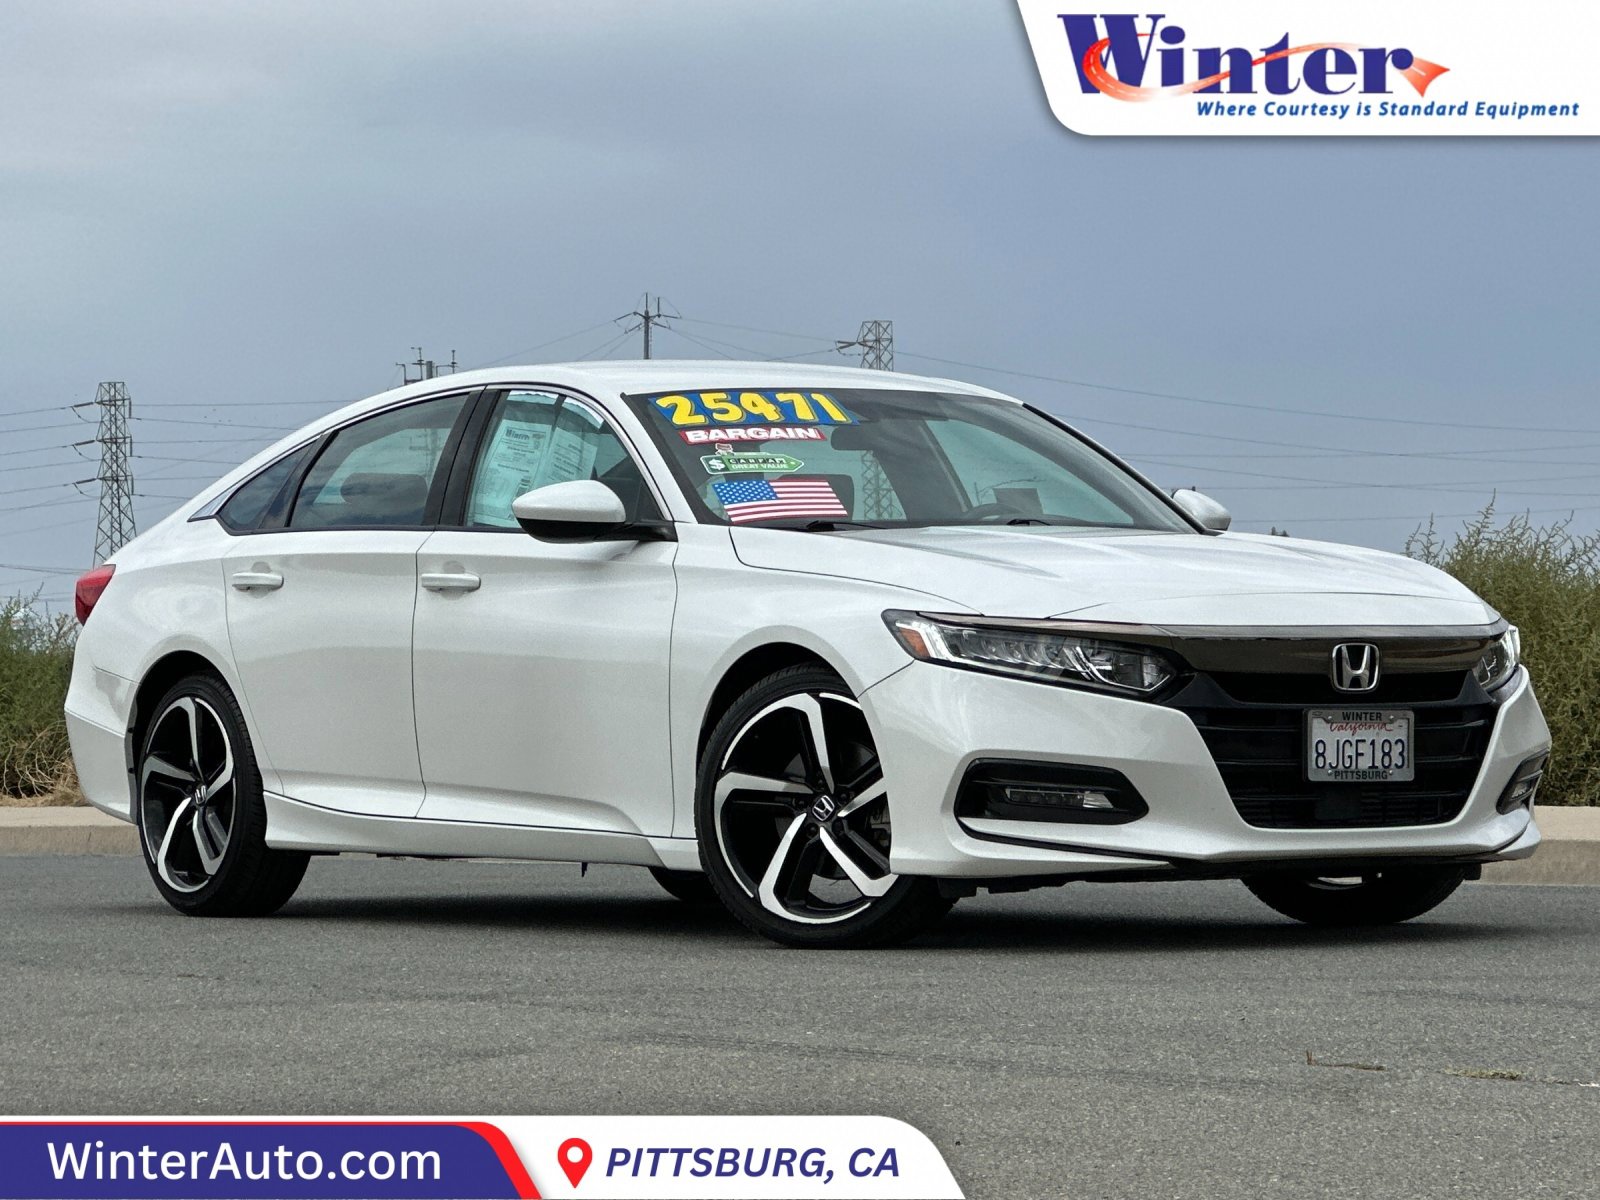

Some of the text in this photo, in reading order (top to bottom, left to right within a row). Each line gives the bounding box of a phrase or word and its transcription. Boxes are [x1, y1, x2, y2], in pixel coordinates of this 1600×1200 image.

[656, 392, 847, 425] 25471
[685, 427, 821, 443] BARGAIN
[1342, 711, 1383, 721] WINTER
[1329, 721, 1394, 736] California
[1315, 738, 1405, 769] 8JGF183
[1334, 770, 1388, 780] PITTSBURG
